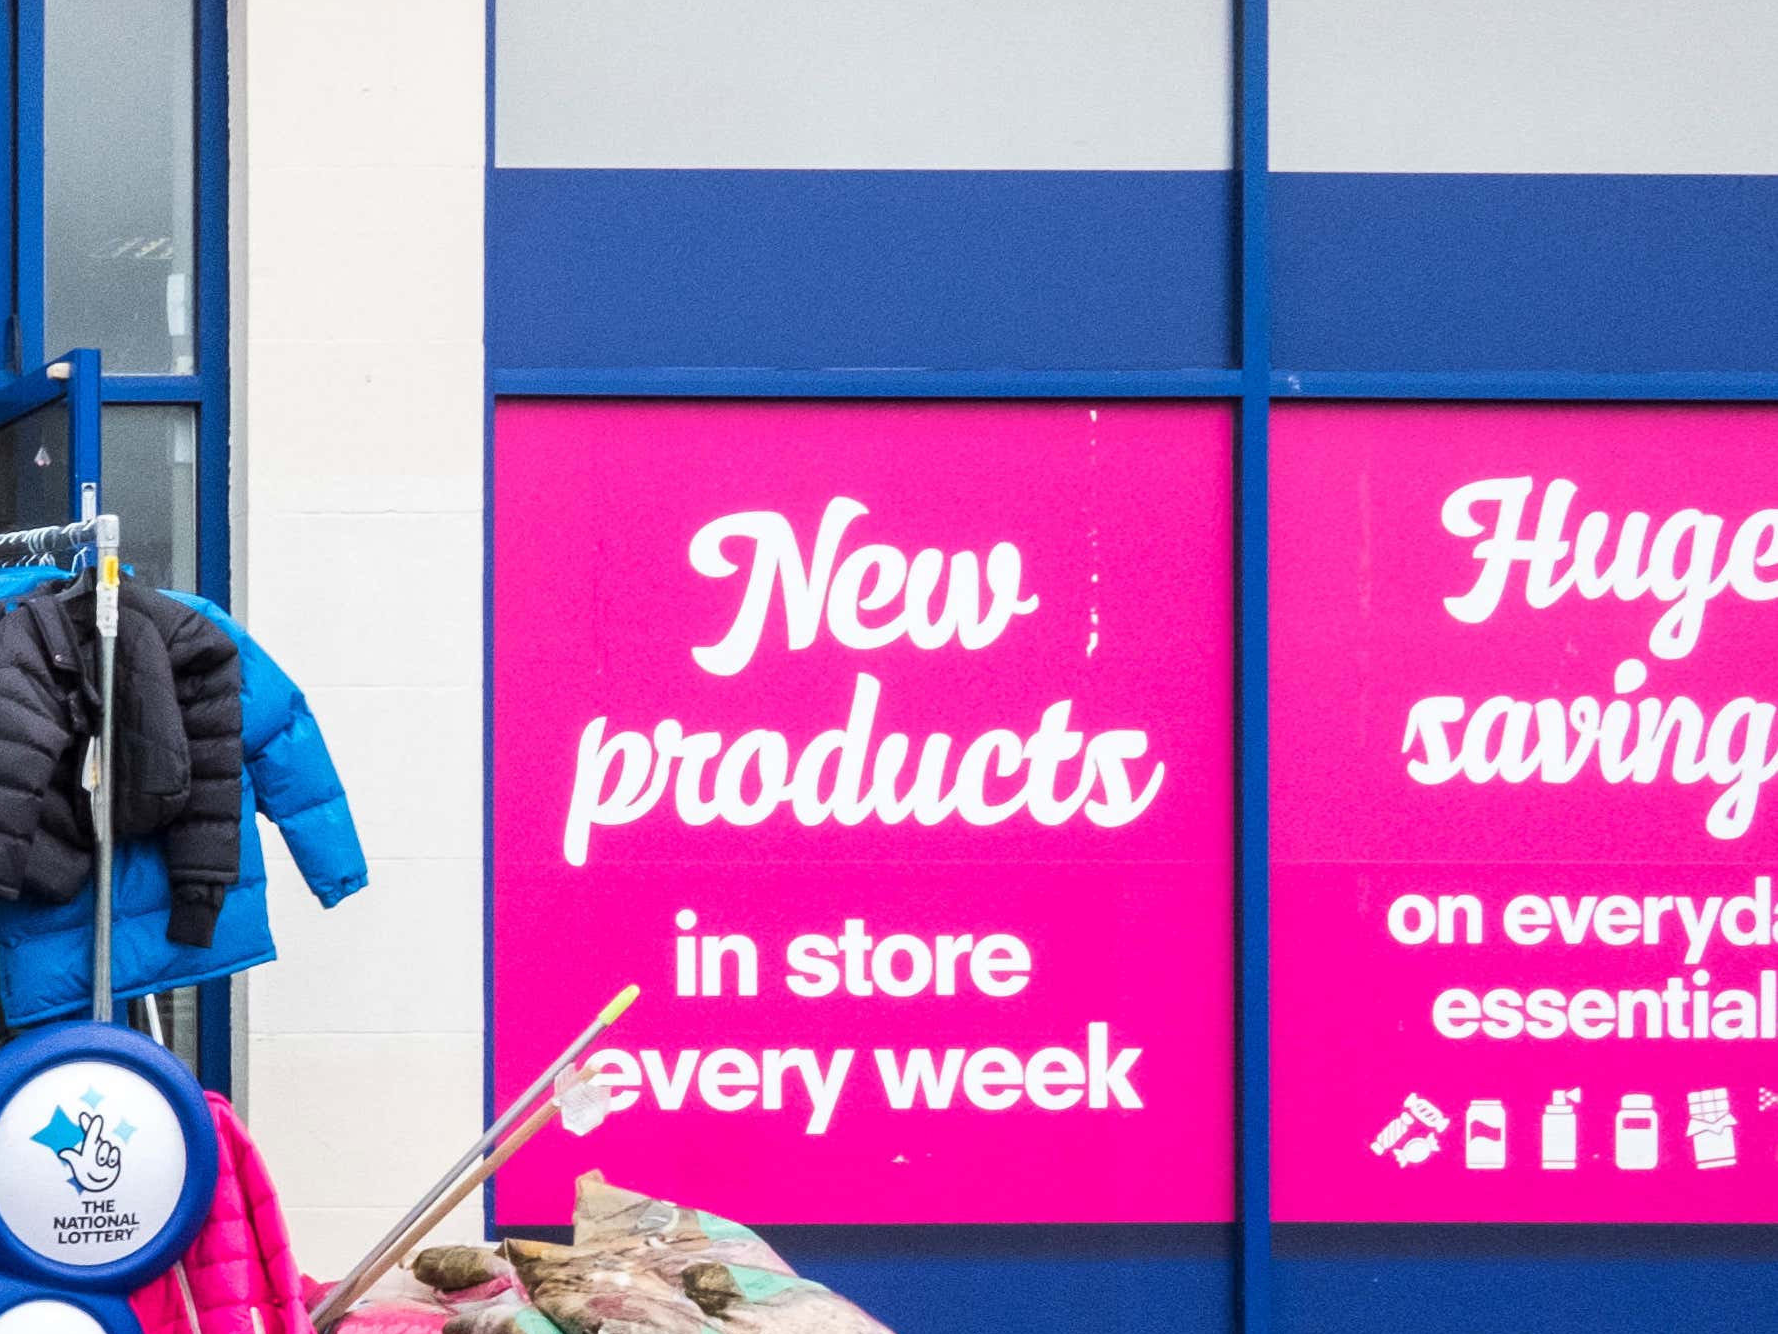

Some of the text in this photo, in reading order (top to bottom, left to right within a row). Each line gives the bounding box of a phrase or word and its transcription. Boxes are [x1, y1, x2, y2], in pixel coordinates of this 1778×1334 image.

[688, 496, 1040, 677] New
[1440, 475, 1778, 661] Huge
[563, 672, 1165, 867] products
[675, 908, 1032, 998] in store
[1387, 875, 1778, 965] on everyd
[584, 1021, 1144, 1135] every week
[53, 1213, 140, 1230] NATIONAL
[58, 1228, 134, 1244] LOTTERY
[81, 1199, 116, 1214] THE
